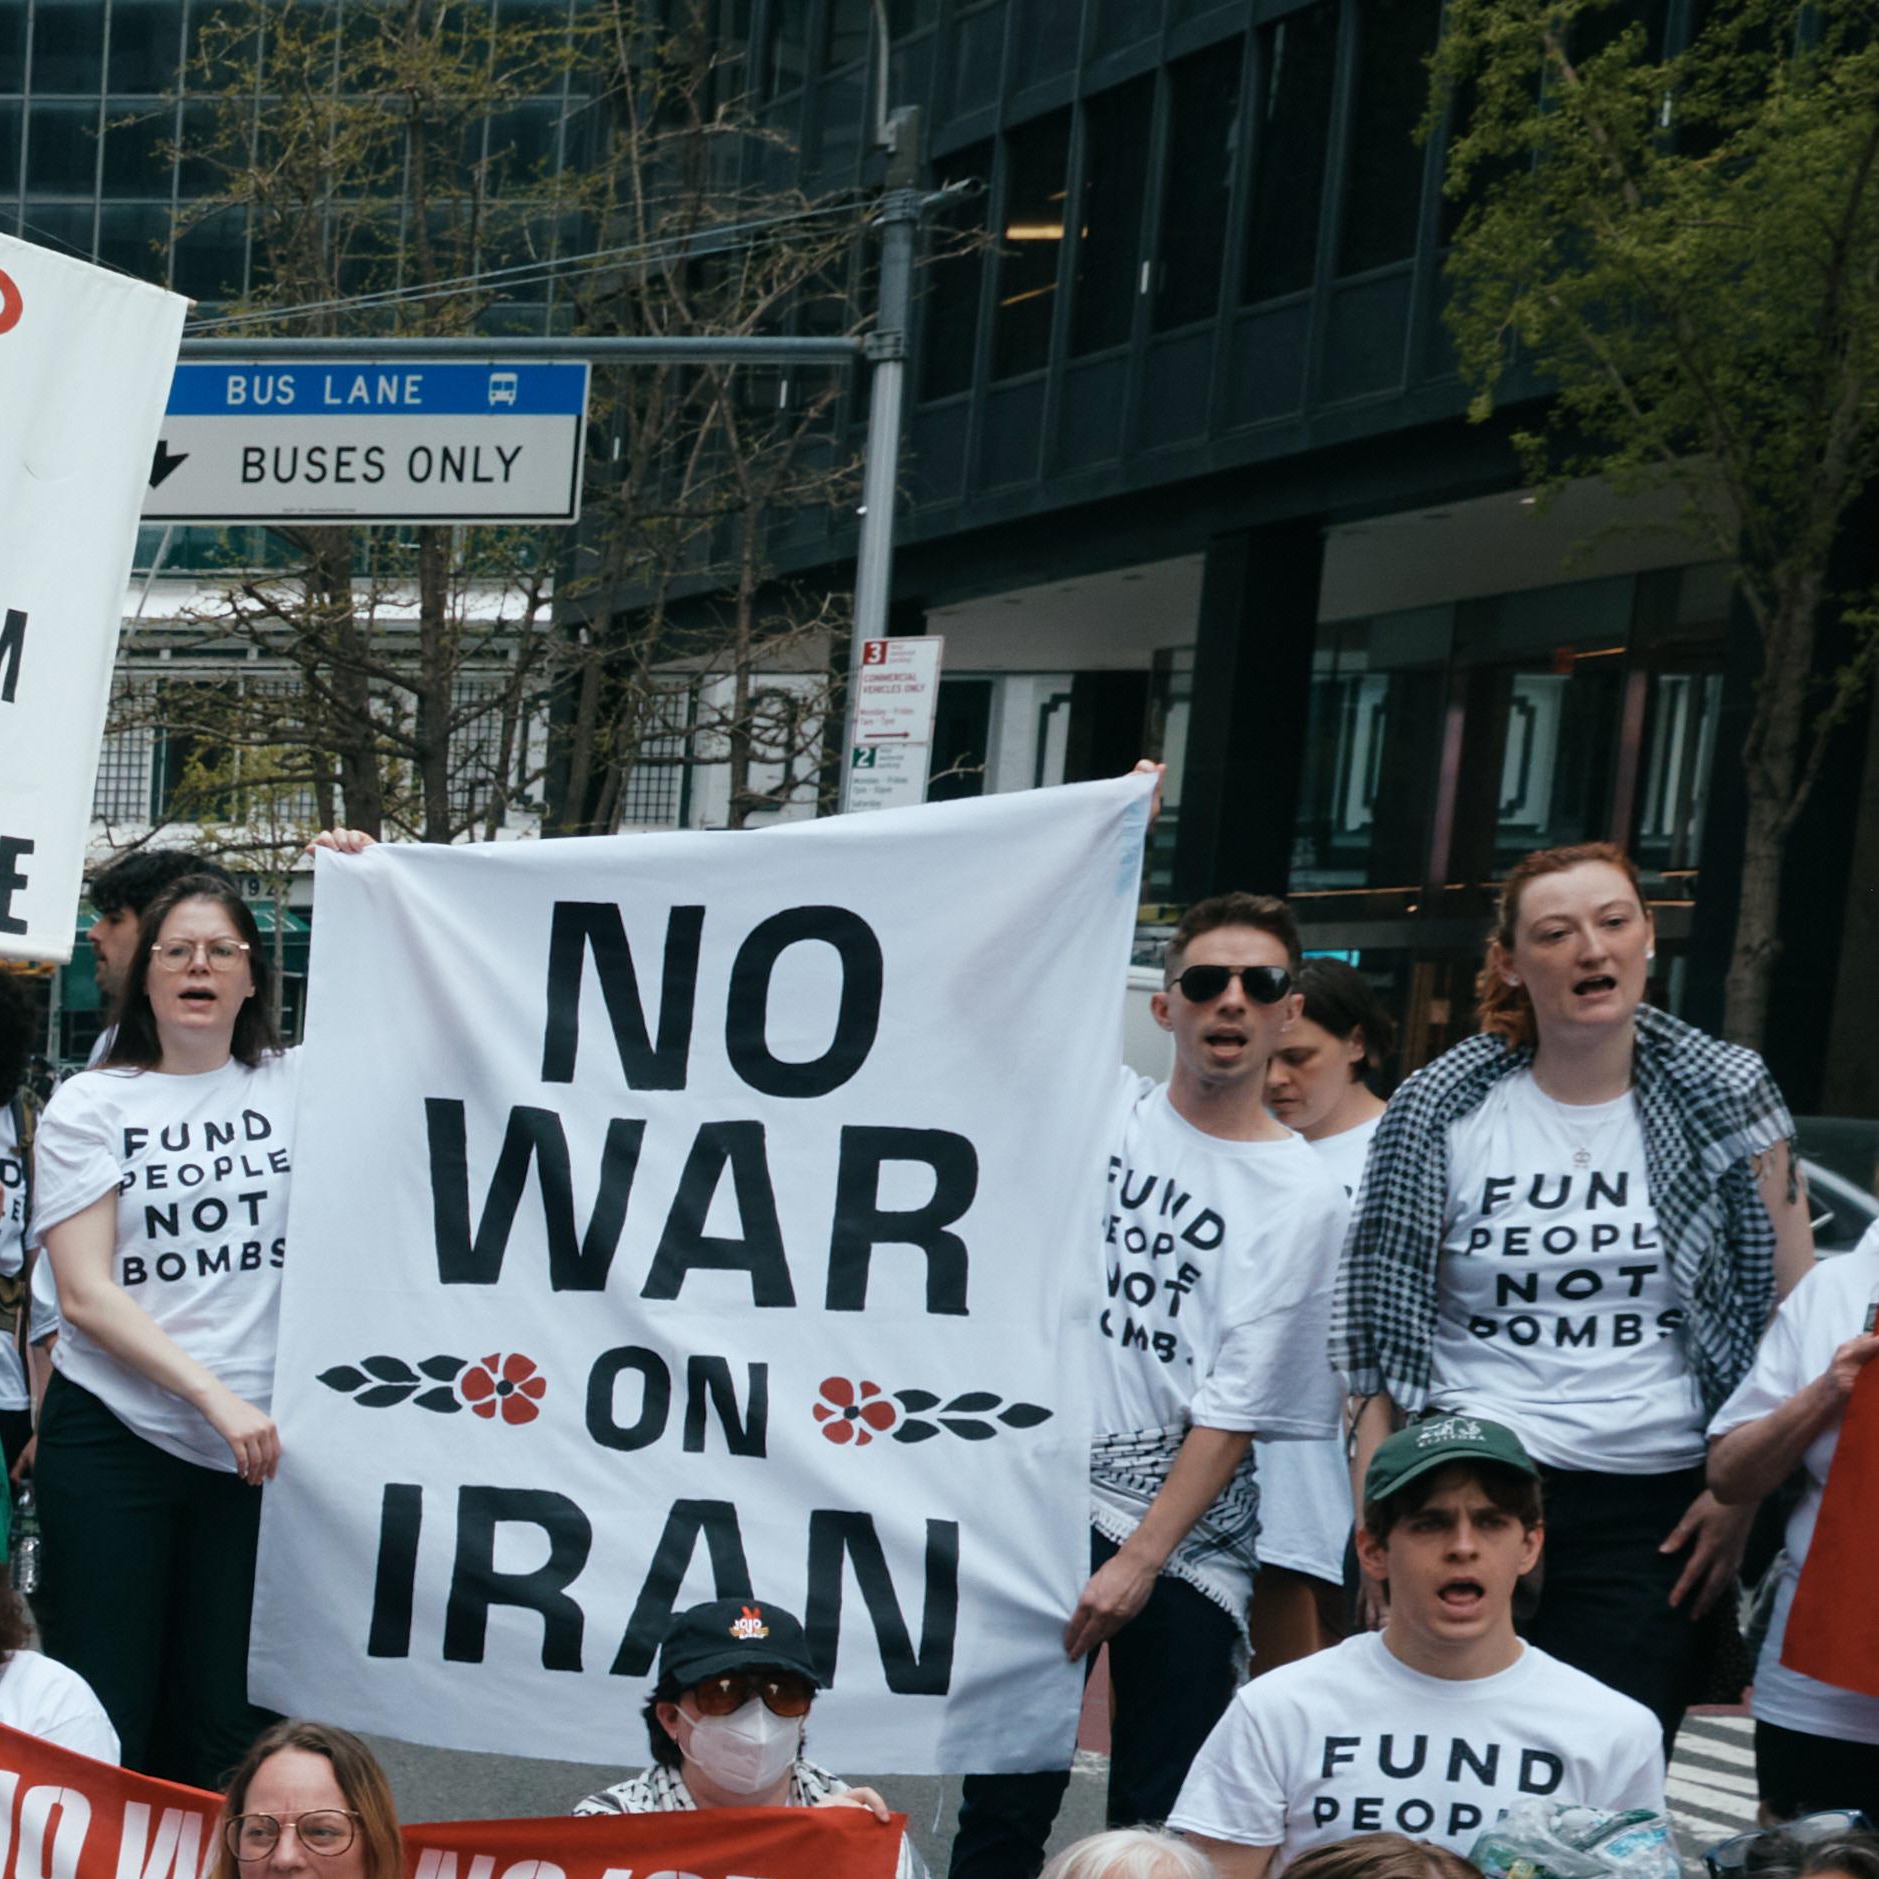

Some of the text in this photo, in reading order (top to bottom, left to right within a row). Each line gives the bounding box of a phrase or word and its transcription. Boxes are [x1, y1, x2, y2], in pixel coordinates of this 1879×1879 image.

[226, 375, 423, 405] BUS LANE
[241, 445, 523, 484] BUSES ONLY
[868, 643, 882, 664] 3
[857, 749, 871, 767] 2
[541, 900, 884, 1099] NO
[122, 1109, 268, 1158] FUND
[117, 1148, 287, 1196] PEOPLE
[1480, 1171, 1628, 1216] FUN
[144, 1191, 268, 1239] NOT
[424, 1097, 979, 1317] WAR
[122, 1236, 288, 1287] BOMBS
[1462, 1223, 1661, 1258] PEOPL
[1495, 1263, 1659, 1308] NOT
[585, 1345, 769, 1459] ON
[361, 1478, 964, 1698] IRAN
[1321, 1734, 1565, 1796] FUND
[1312, 1796, 1482, 1841] PEOP
